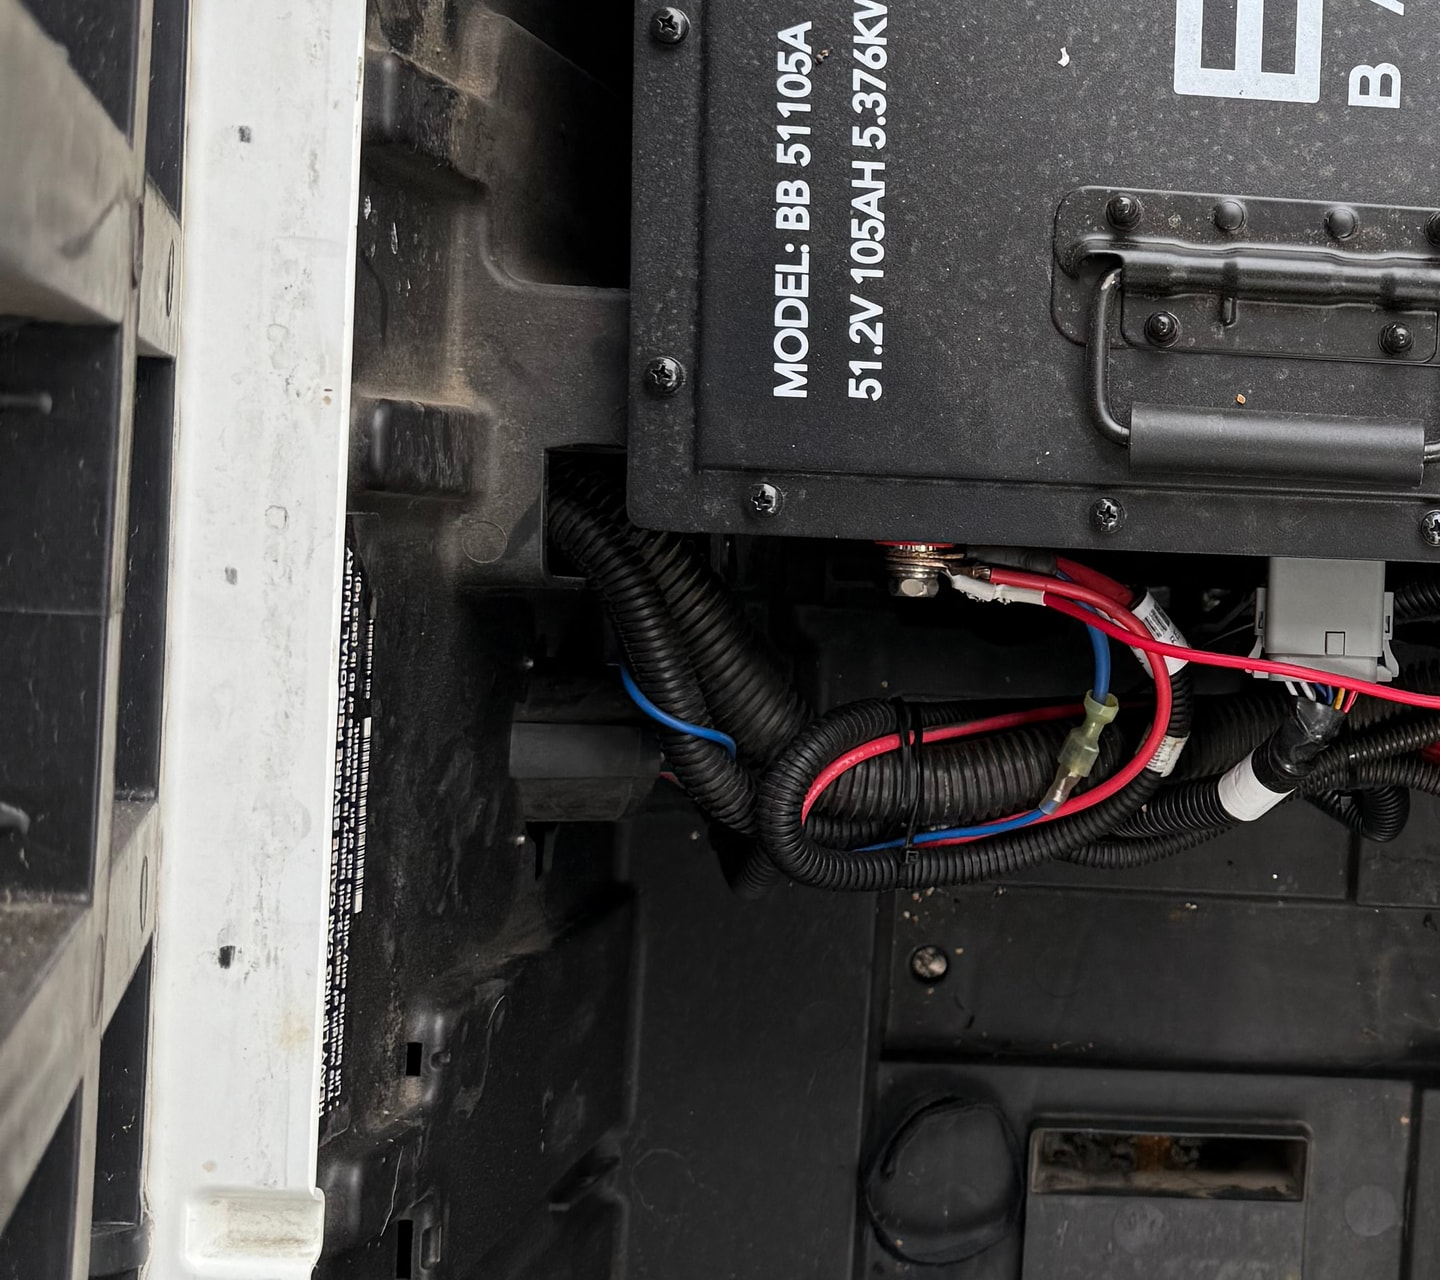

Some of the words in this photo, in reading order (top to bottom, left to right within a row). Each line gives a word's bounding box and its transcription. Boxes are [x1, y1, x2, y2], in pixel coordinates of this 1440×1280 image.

[776, 179, 810, 231] BB
[850, 161, 885, 284] 105AH
[773, 243, 809, 398] MODEL:
[848, 294, 884, 402] 51.2V
[342, 546, 354, 622] INJURY
[336, 626, 350, 742] PERSONAL
